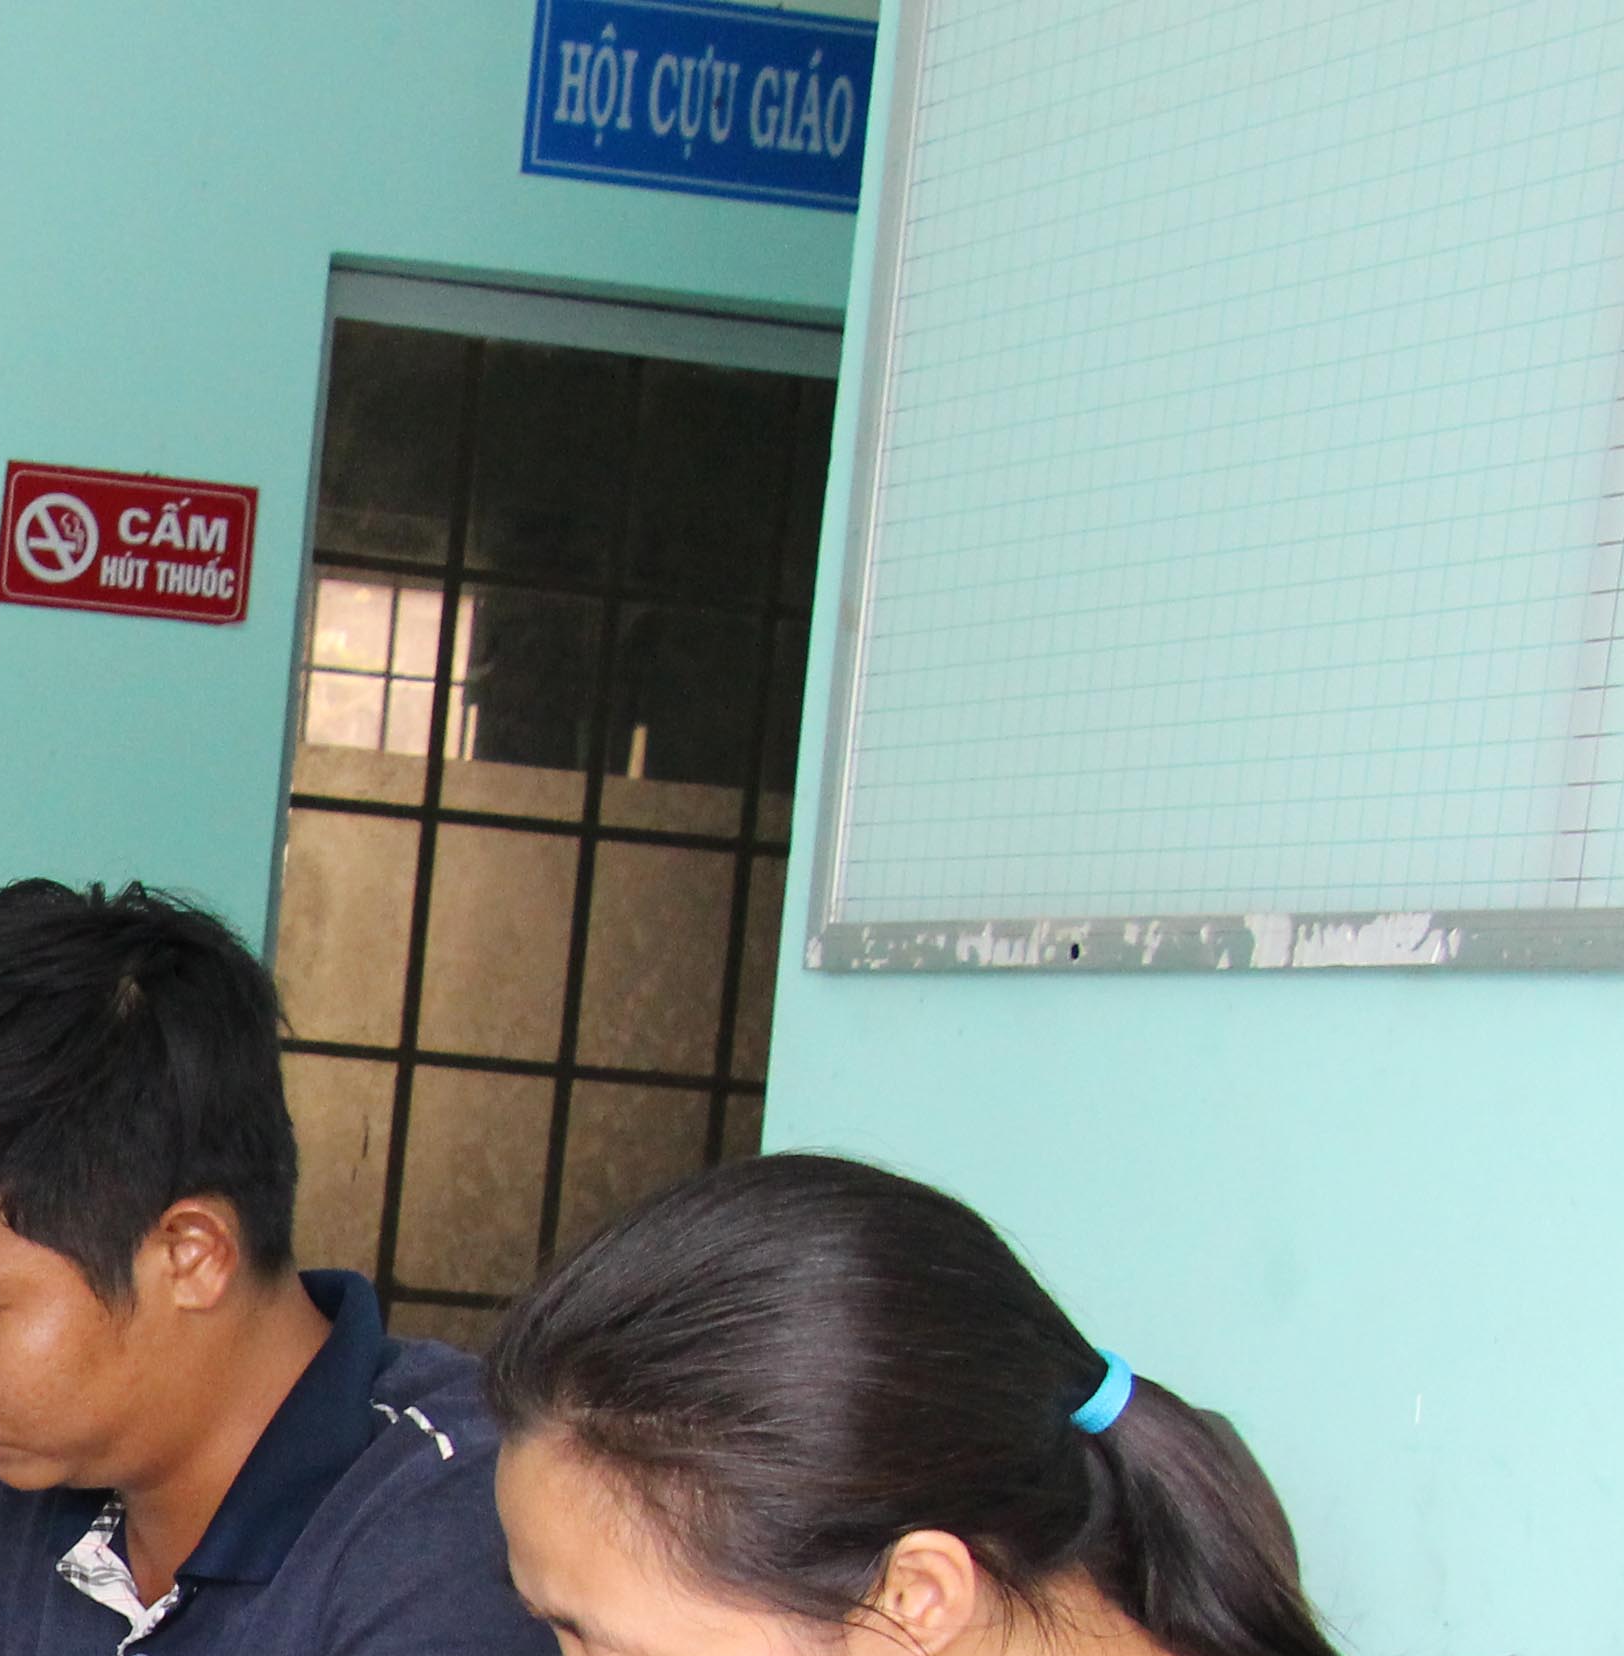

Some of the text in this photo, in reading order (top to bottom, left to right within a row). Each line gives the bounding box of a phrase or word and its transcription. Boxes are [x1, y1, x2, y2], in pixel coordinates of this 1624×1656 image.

[554, 21, 854, 160] HỘI CỰU GIÁO
[118, 498, 229, 554] CẤM
[101, 551, 235, 600] HÚT THUỐC
